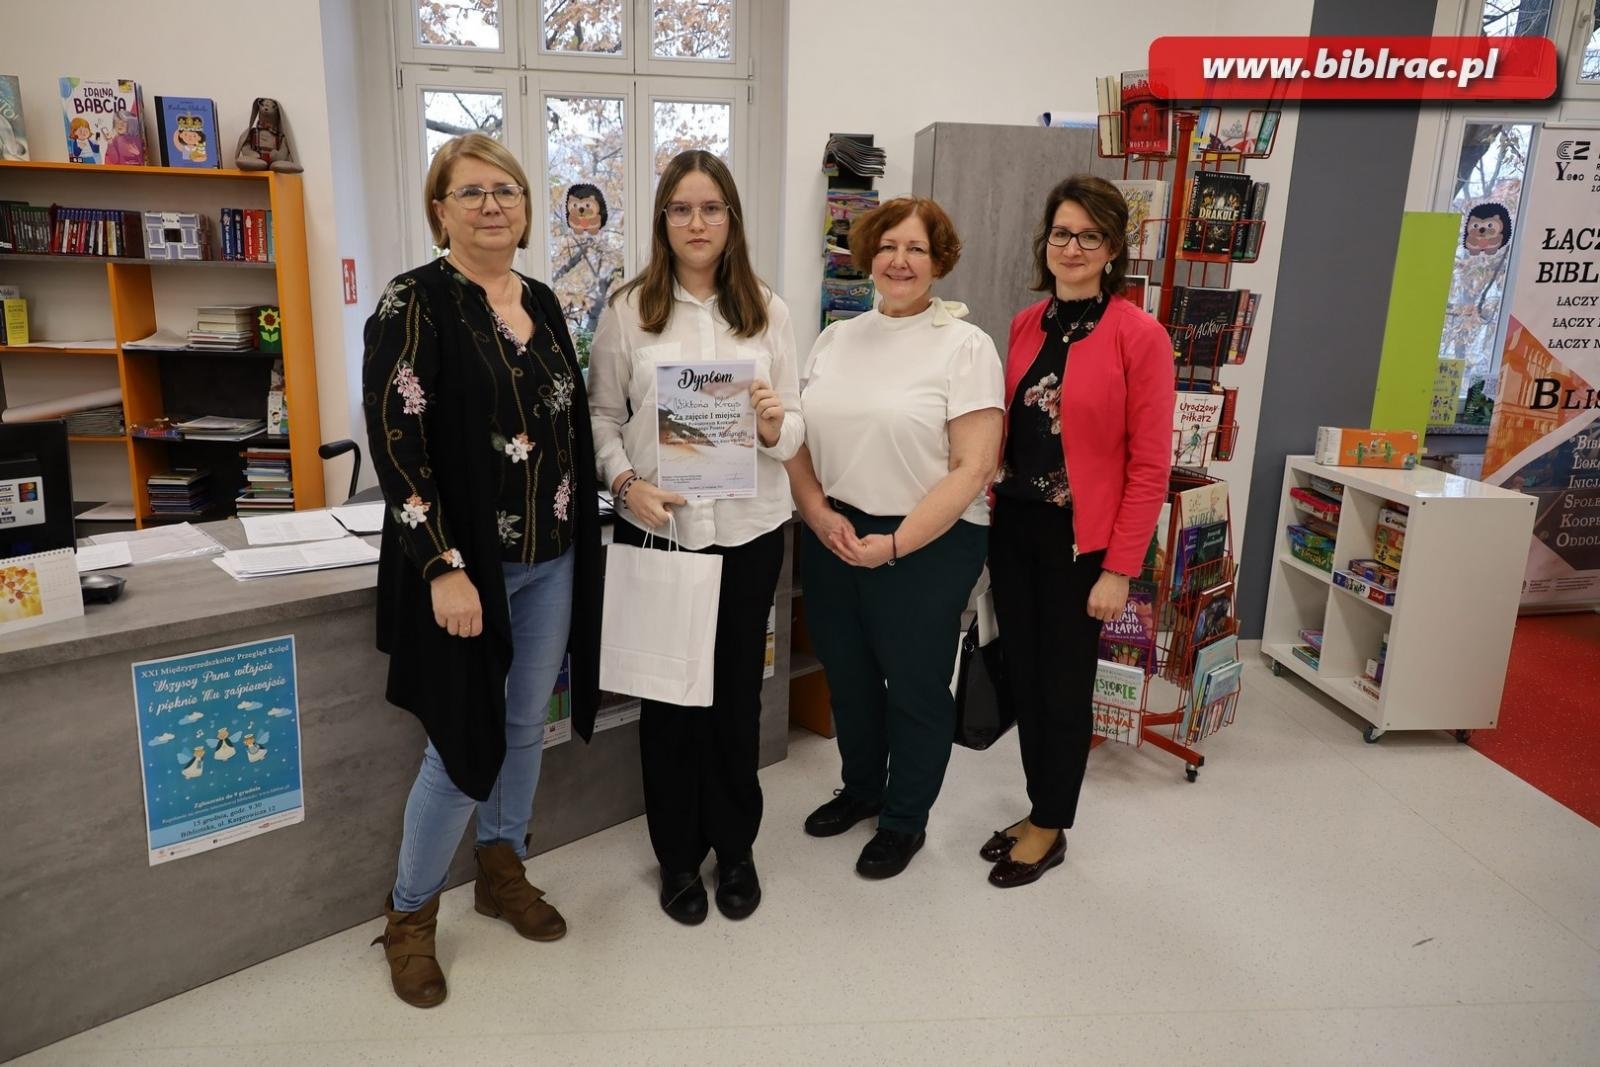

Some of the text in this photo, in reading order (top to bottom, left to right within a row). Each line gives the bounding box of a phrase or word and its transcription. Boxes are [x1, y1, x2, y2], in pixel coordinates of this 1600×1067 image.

[83, 87, 114, 98] ZDALNA
[1535, 261, 1600, 283] BIBL
[677, 368, 734, 392] Dyplom
[685, 413, 708, 422] zajęcie
[715, 411, 741, 421] miejsca
[1180, 402, 1218, 415] Urodzony
[1180, 412, 1212, 424] piłkarz
[1114, 622, 1143, 634] ŁAPKI
[141, 668, 159, 679] XXI
[160, 656, 236, 675] Międzyprzedszkolny
[237, 648, 268, 660] Przegląd
[152, 660, 273, 693] Wszyscy Pana witajcie
[148, 701, 154, 713] i
[155, 694, 198, 716] pięknie
[224, 675, 287, 699] zaśpiewajcie
[1094, 678, 1137, 701] ISTORIE
